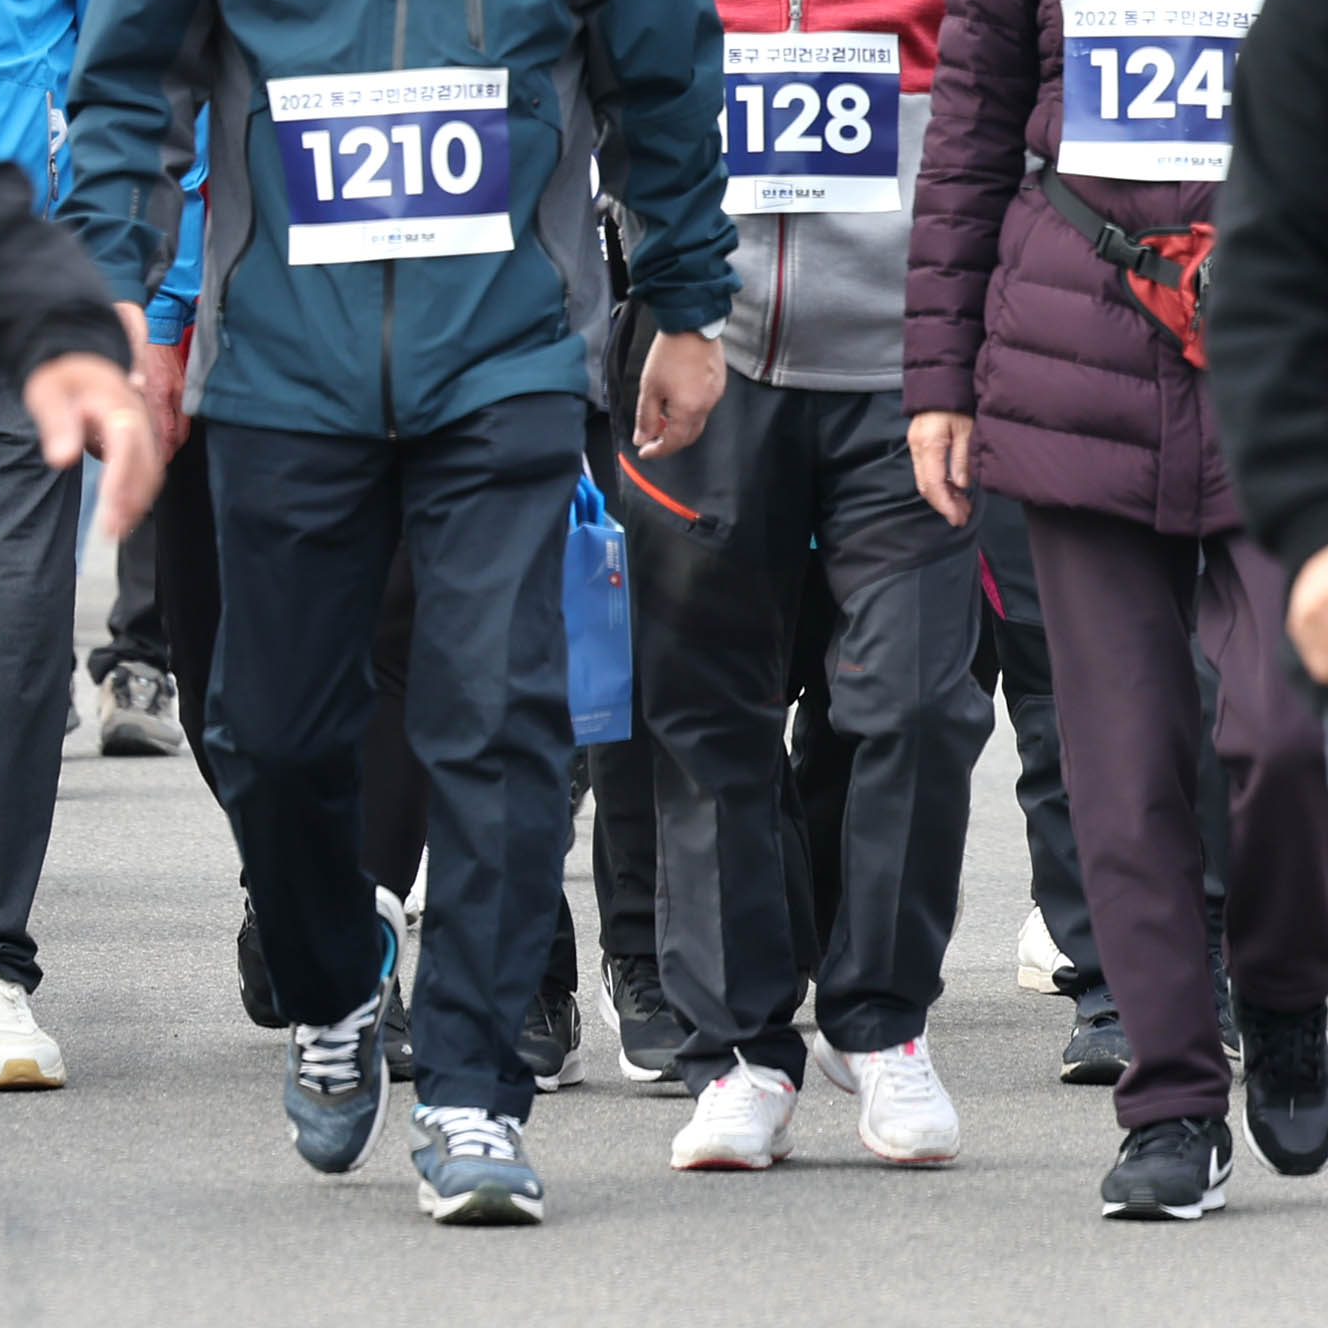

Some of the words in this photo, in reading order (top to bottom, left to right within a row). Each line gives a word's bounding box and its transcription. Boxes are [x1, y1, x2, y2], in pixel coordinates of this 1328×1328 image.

[1074, 10, 1117, 27] 2022
[1125, 10, 1155, 26] 동구
[728, 48, 760, 64] 동구
[767, 47, 891, 64] 구민건강걷기대회
[280, 93, 323, 110] 2022
[330, 90, 362, 107] 동구
[371, 83, 501, 105] 구민건강걷기대회
[1090, 46, 1241, 120] 124
[301, 120, 483, 201] 1210
